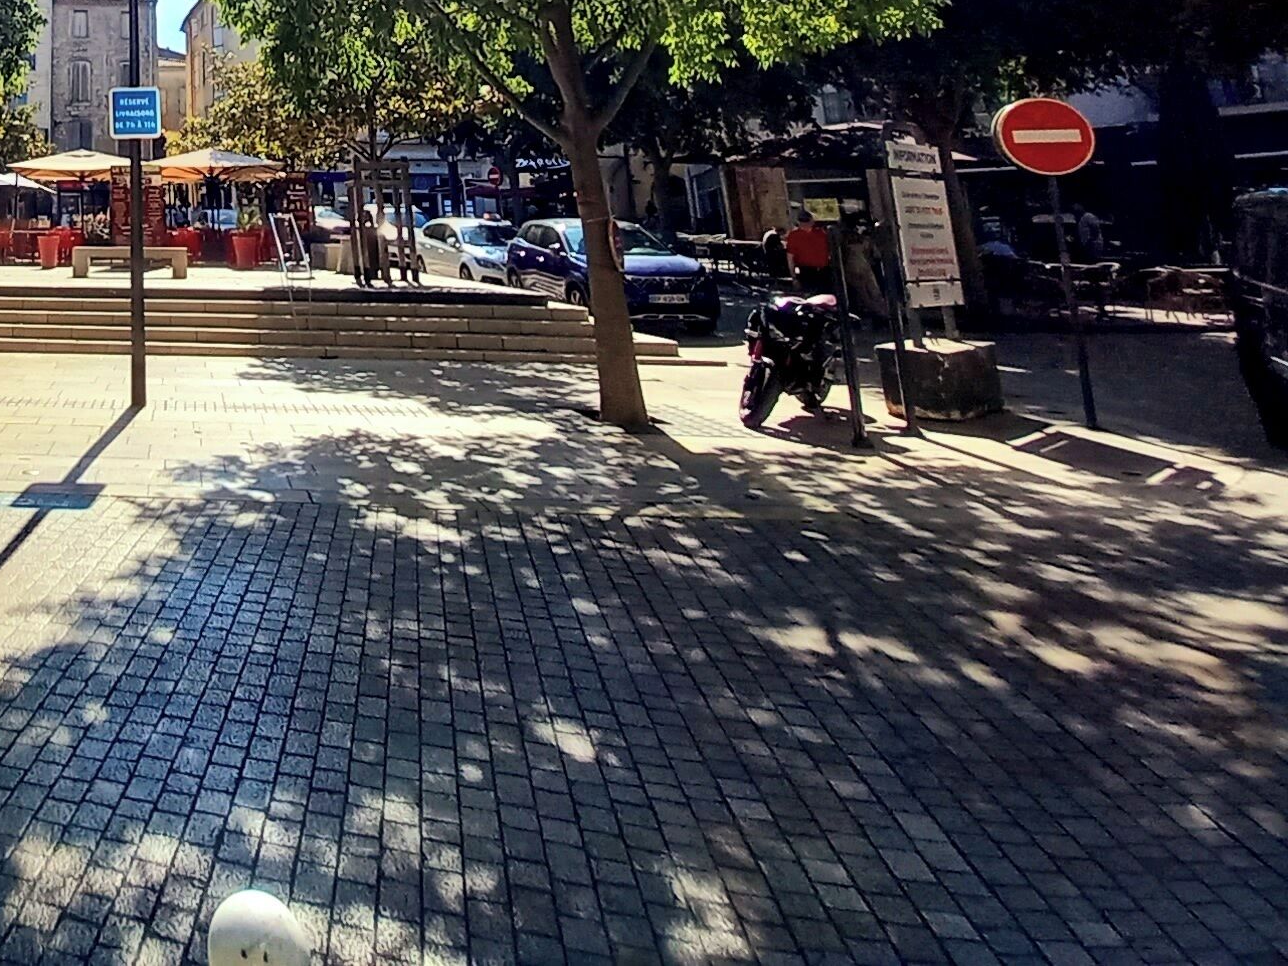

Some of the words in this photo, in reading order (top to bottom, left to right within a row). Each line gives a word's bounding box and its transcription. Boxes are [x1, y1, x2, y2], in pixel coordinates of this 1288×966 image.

[119, 97, 149, 106] RÉSERVÉ
[115, 109, 154, 117] LIVRAISONS
[115, 121, 124, 129] DE
[137, 119, 143, 129] À
[893, 149, 936, 164] INFORMATION
